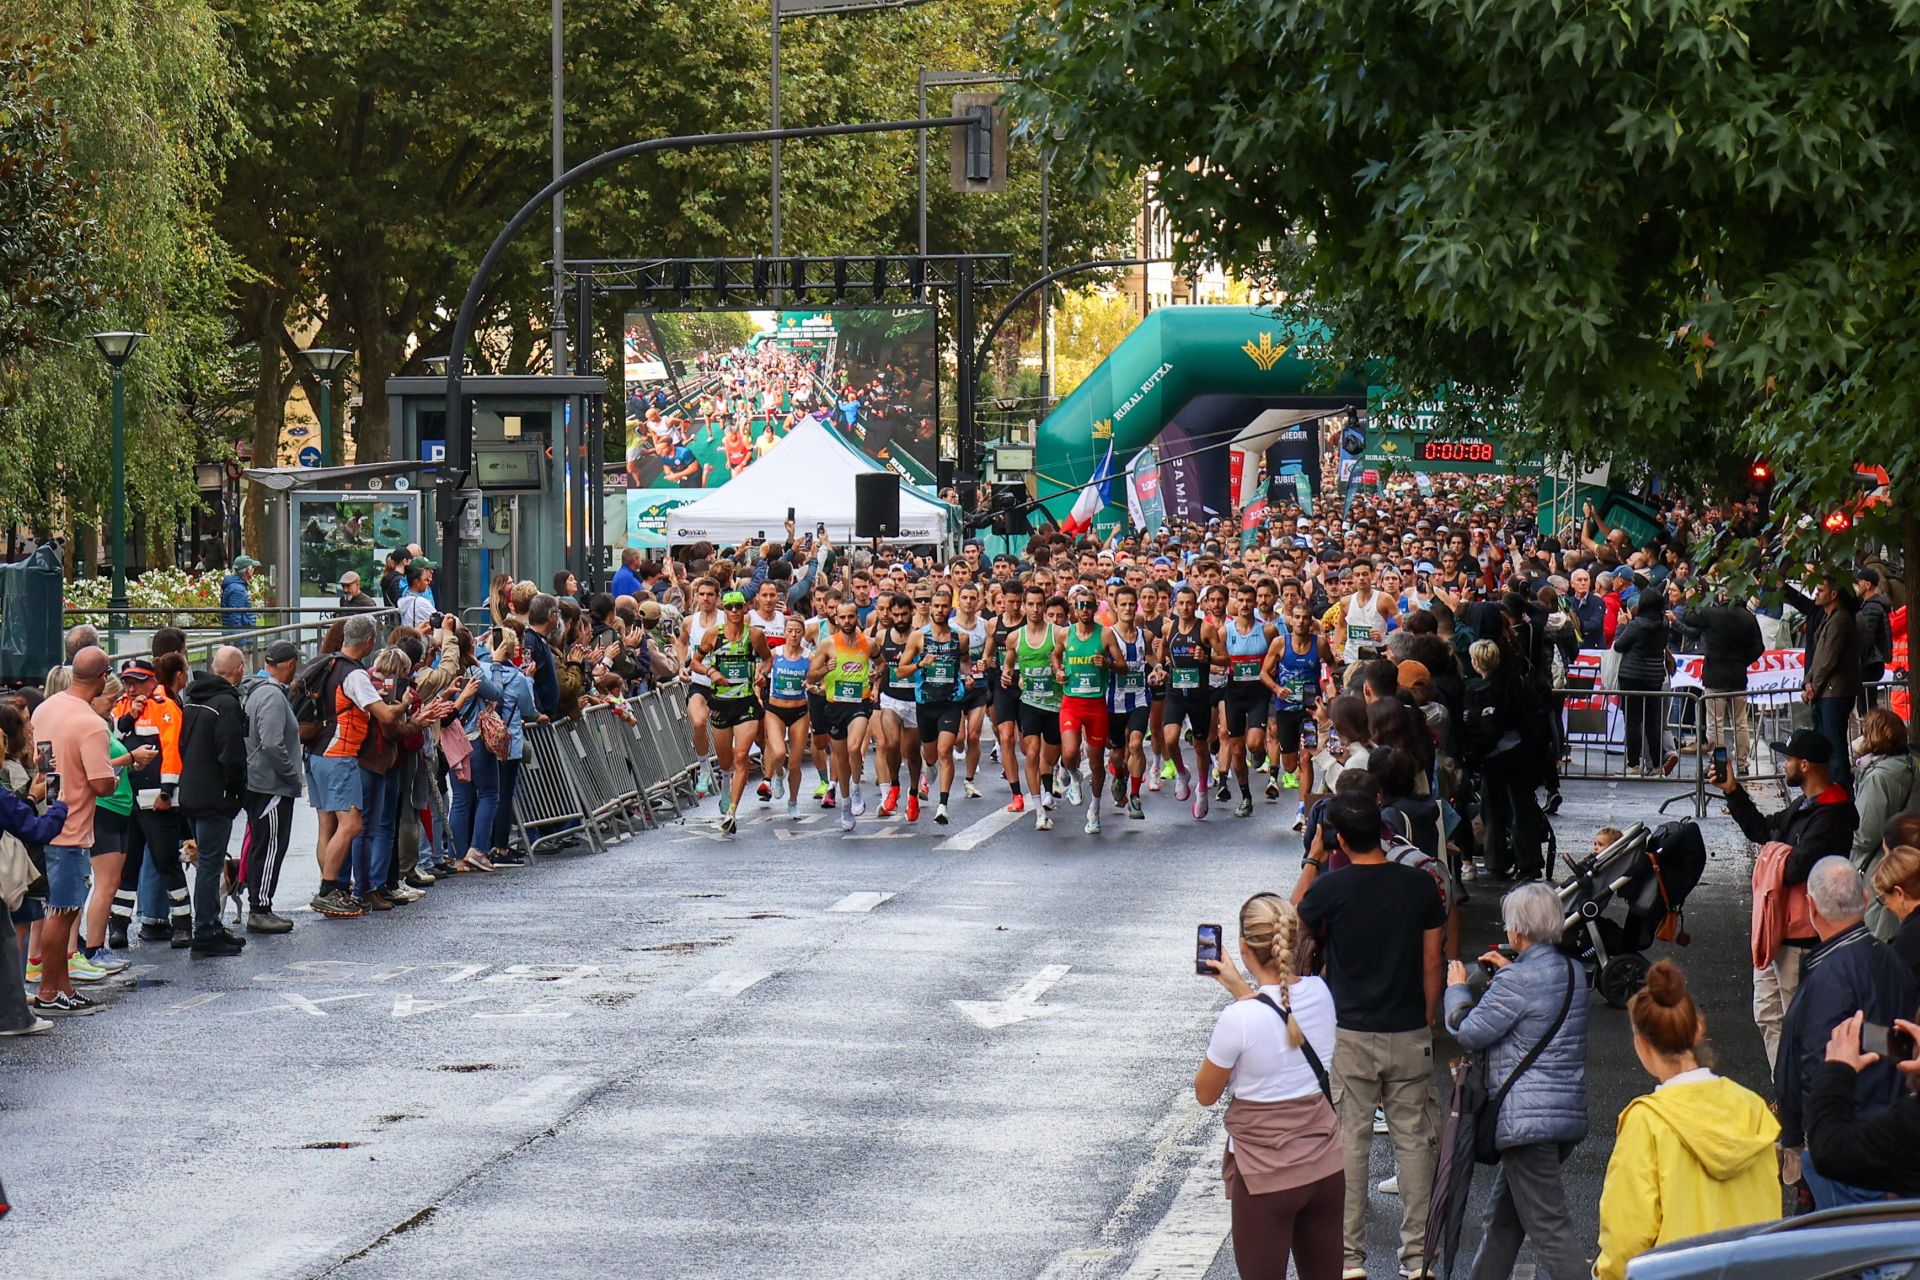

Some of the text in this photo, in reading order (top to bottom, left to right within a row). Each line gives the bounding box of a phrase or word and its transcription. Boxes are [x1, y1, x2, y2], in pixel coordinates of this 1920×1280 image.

[1113, 362, 1173, 421] RURAL KUTXA
[1425, 443, 1492, 460] 0:00:08
[1350, 630, 1368, 638] 1341
[728, 669, 740, 677] 22
[935, 668, 947, 676] 23
[786, 681, 794, 690] 9
[1033, 682, 1045, 690] 24
[1126, 678, 1136, 686] 10
[842, 687, 854, 695] 20
